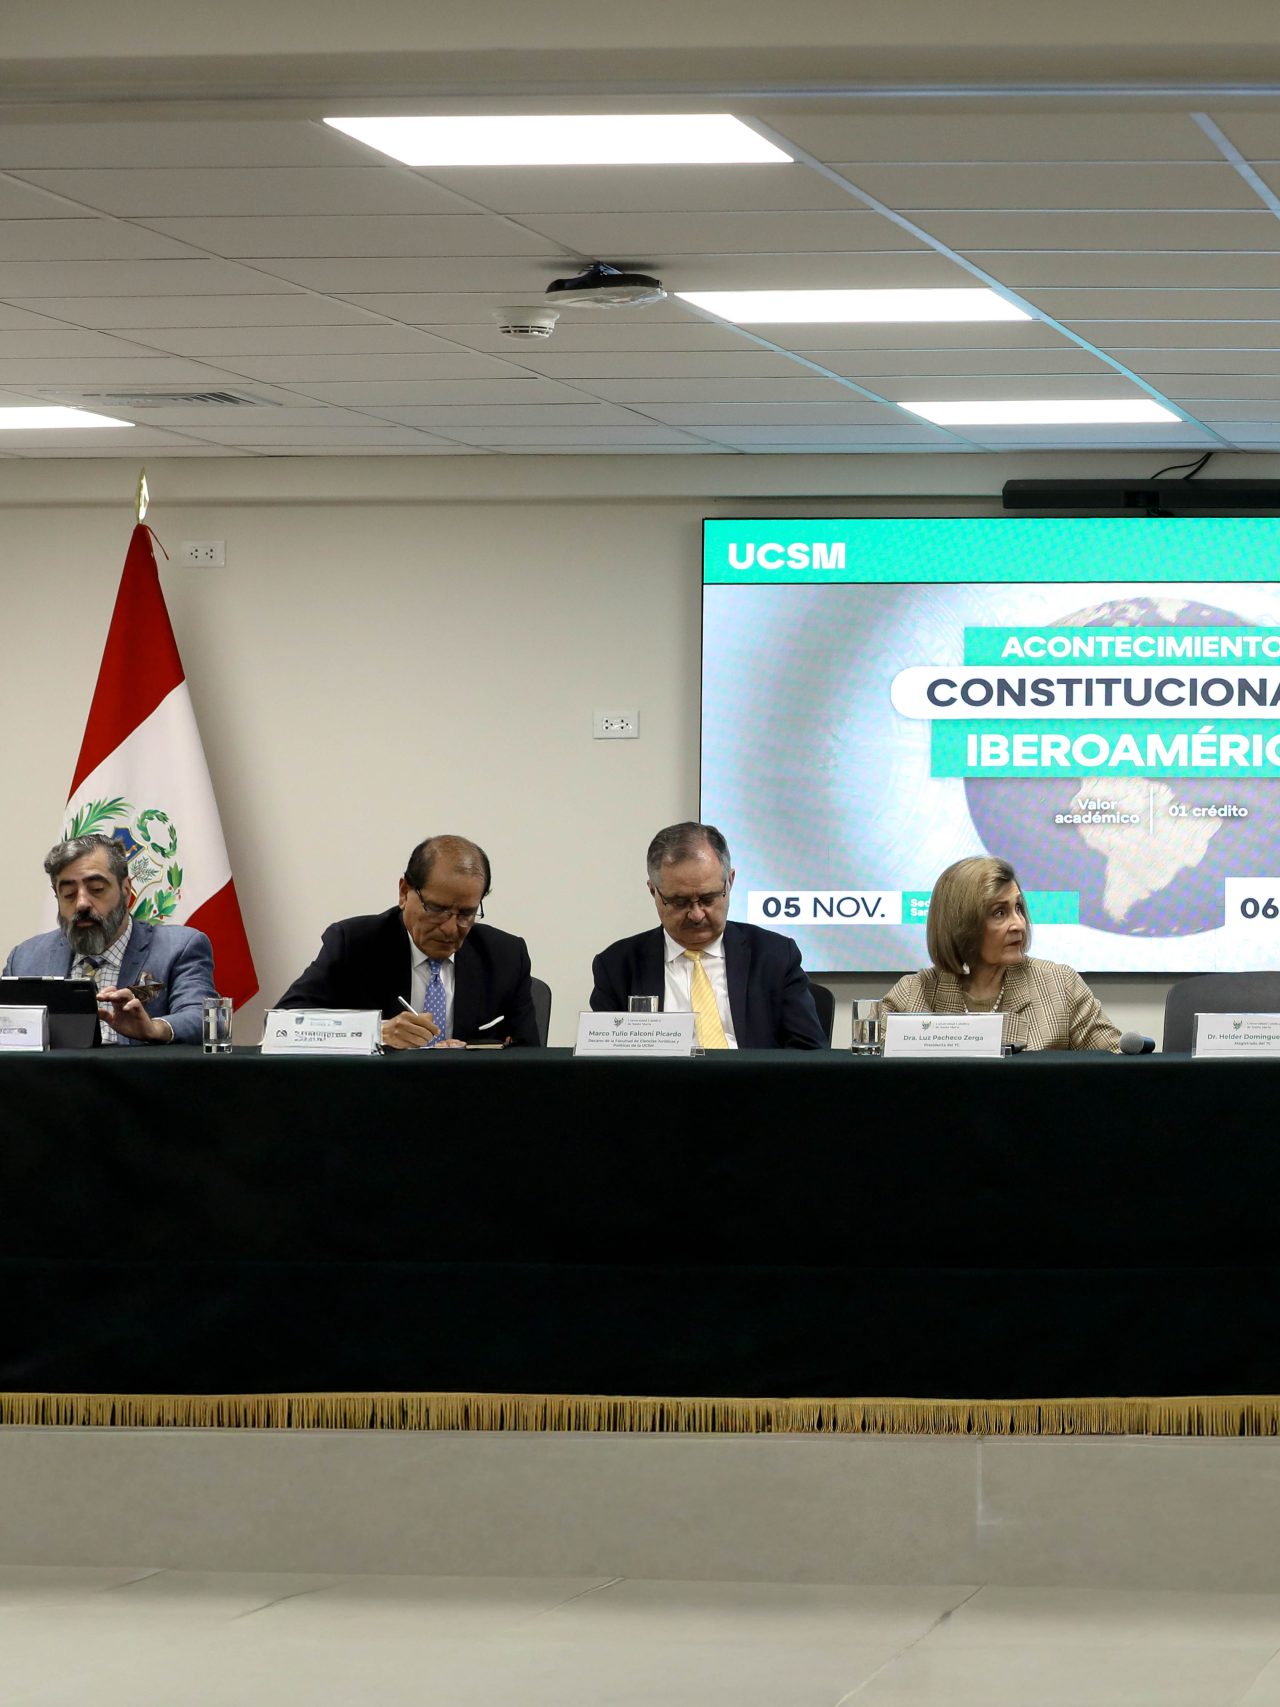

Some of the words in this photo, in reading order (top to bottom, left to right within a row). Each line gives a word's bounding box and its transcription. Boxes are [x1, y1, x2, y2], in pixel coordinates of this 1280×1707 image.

[728, 542, 846, 570] UCSM
[1077, 798, 1118, 811] Valor
[1168, 805, 1188, 817] 01
[1192, 804, 1249, 817] crédito
[1055, 811, 1140, 824] académico
[762, 896, 801, 918] 05
[813, 896, 886, 918] NOV.
[910, 898, 931, 908] Sed
[1240, 897, 1280, 919] 06
